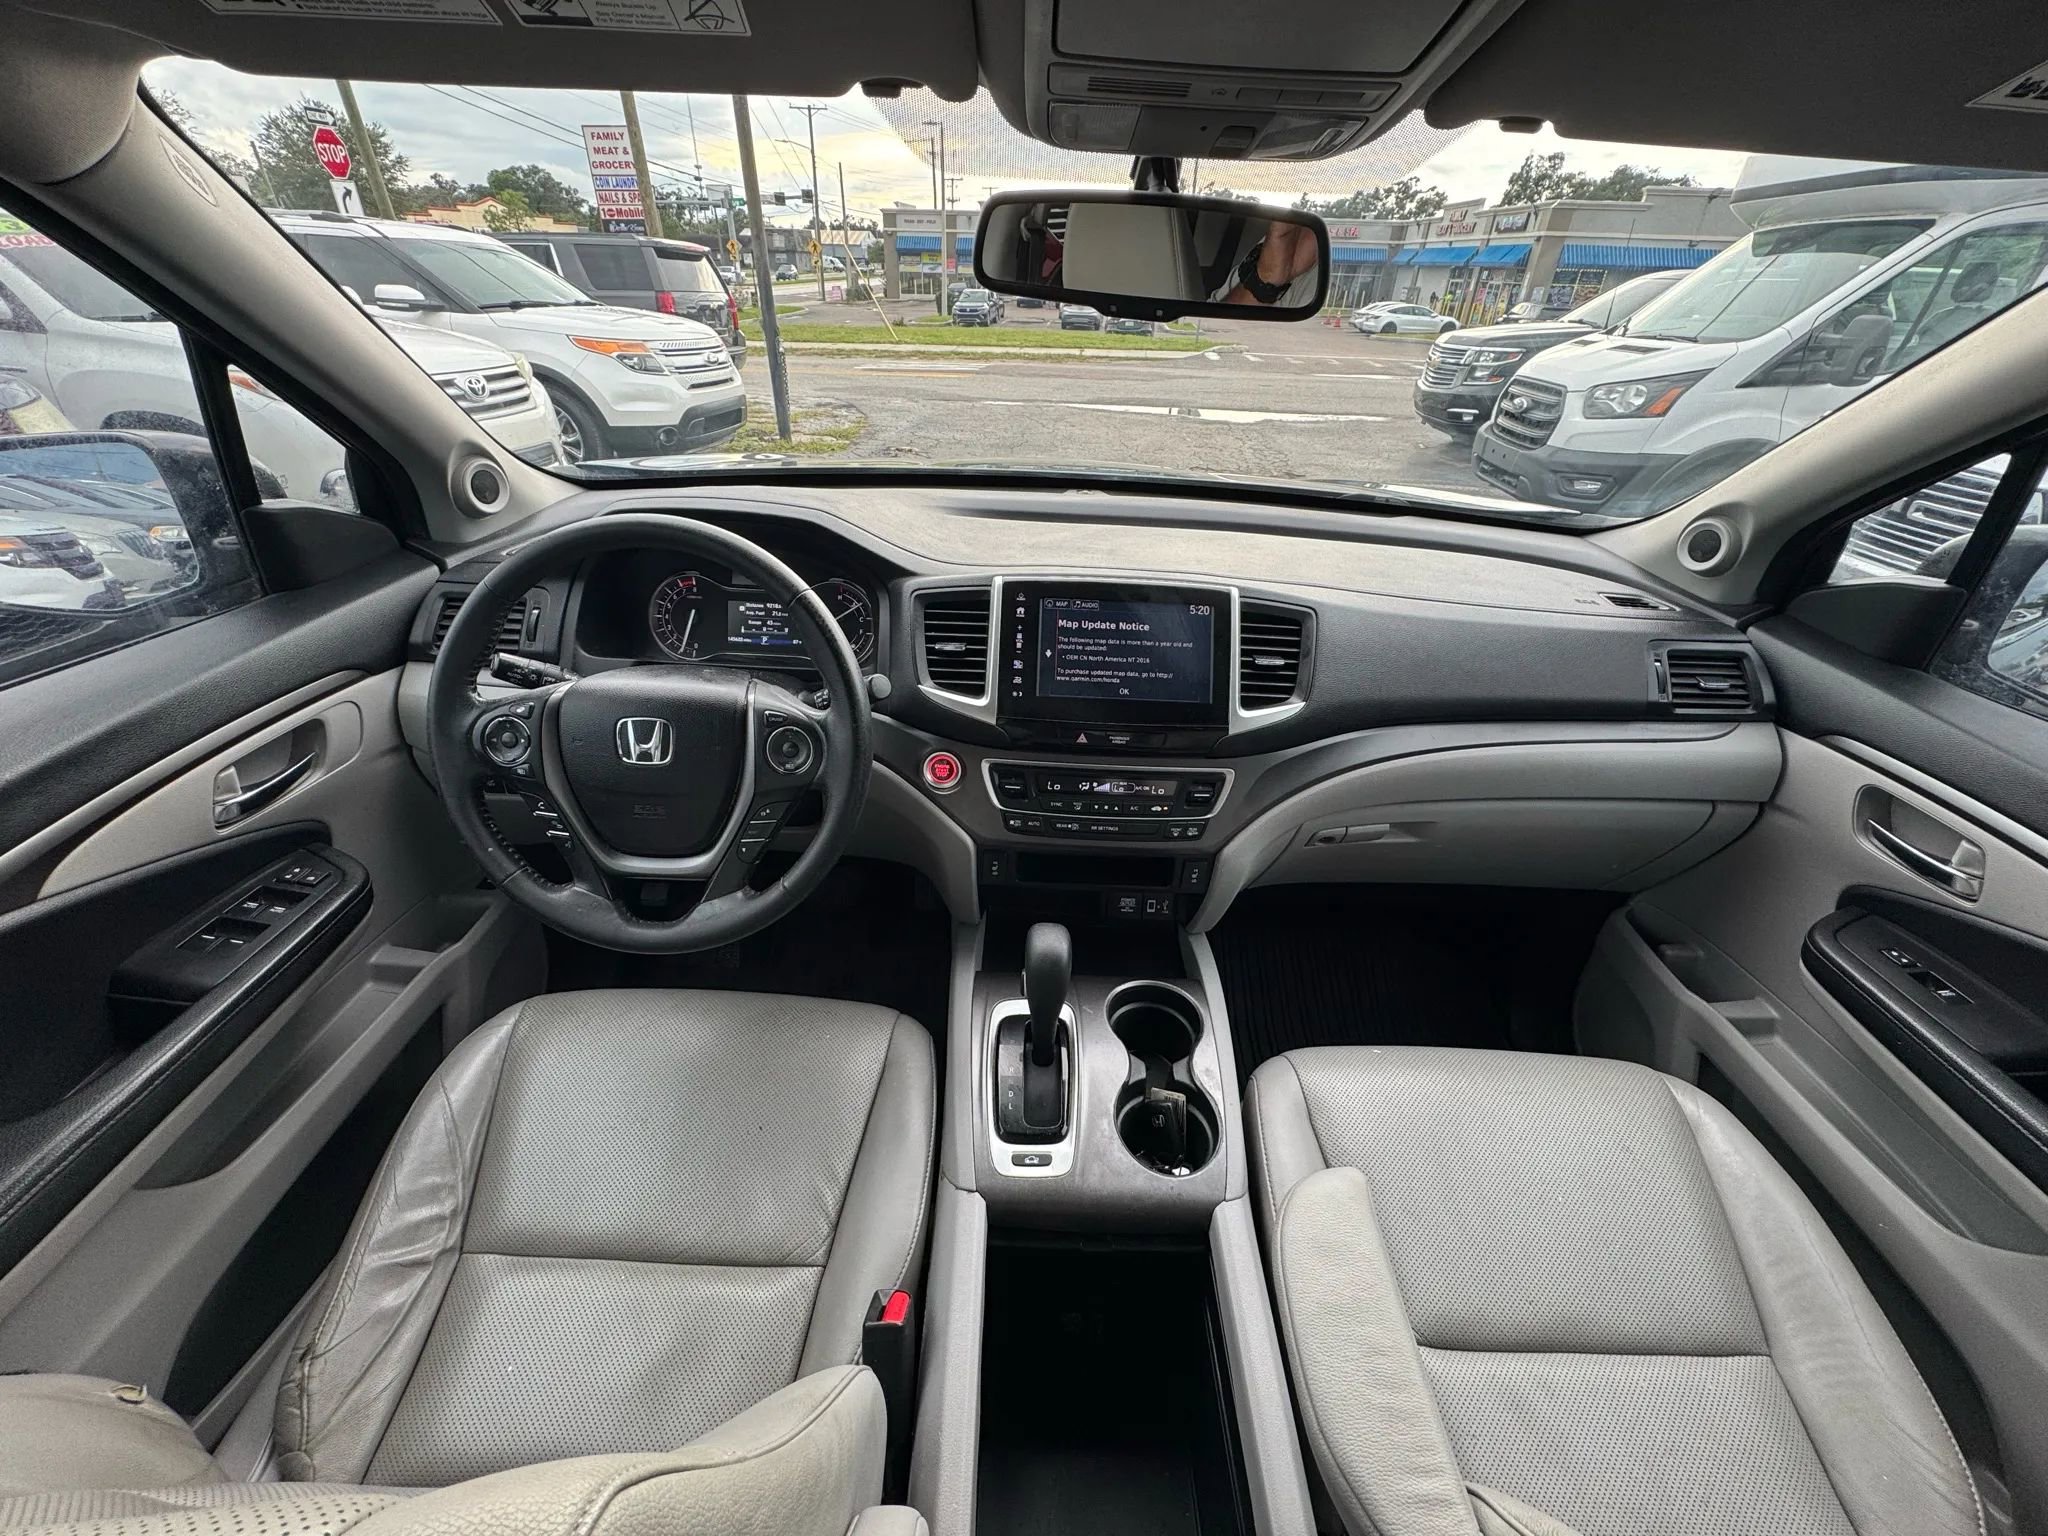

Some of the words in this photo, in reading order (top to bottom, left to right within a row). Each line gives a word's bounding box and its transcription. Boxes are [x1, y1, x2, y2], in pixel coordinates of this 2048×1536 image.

[590, 132, 624, 140] FAMILY
[318, 143, 346, 164] STOP
[593, 146, 619, 155] MEAT
[622, 146, 630, 155] &
[594, 177, 610, 188] COIN
[598, 192, 620, 204] NAILS
[621, 192, 627, 203] &
[1189, 604, 1210, 616] 5:20
[1058, 619, 1079, 630] Map
[1081, 620, 1116, 630] Update
[1118, 622, 1150, 632] Notice
[1119, 688, 1130, 696] OK
[1048, 781, 1060, 790] Lo
[1152, 786, 1164, 794] Lo
